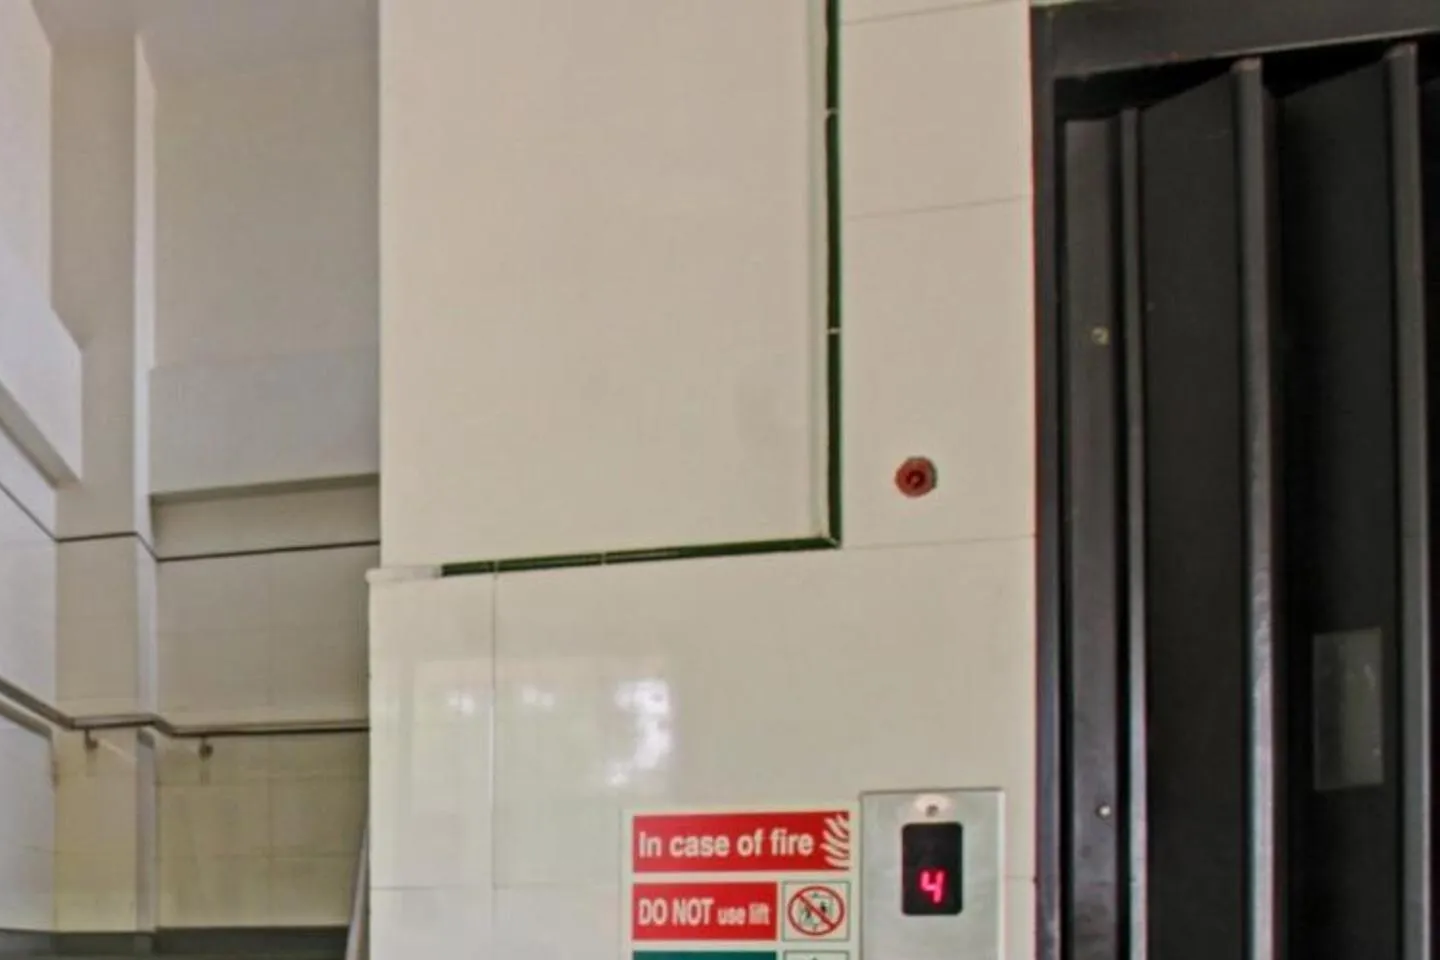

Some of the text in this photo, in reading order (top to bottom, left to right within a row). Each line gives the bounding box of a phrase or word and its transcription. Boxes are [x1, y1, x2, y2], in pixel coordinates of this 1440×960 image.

[638, 829, 815, 857] In case of fire
[919, 869, 945, 903] 4
[637, 897, 770, 926] DO NOT use lift
